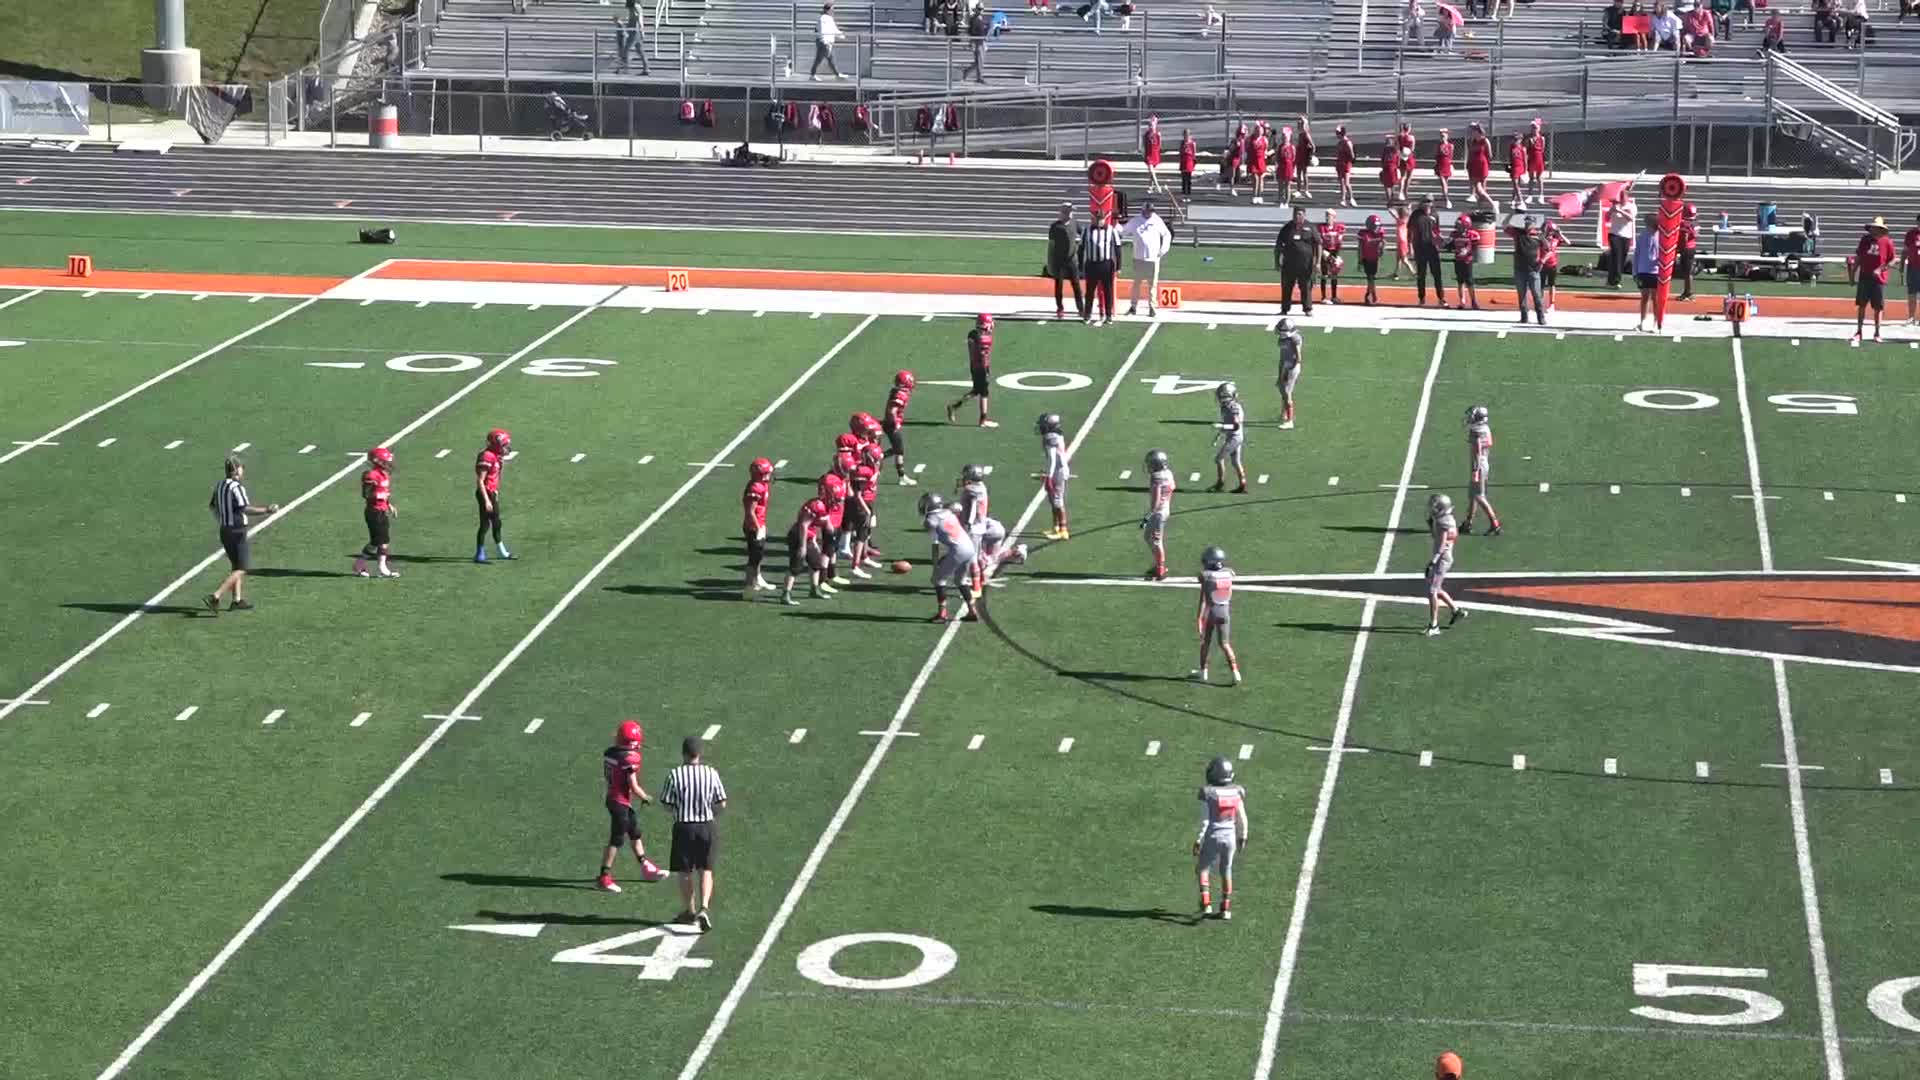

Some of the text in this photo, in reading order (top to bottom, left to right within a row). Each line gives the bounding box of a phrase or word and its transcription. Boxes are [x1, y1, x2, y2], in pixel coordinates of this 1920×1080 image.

[70, 258, 86, 276] 10
[671, 273, 687, 291] 20
[1161, 289, 1178, 306] 30
